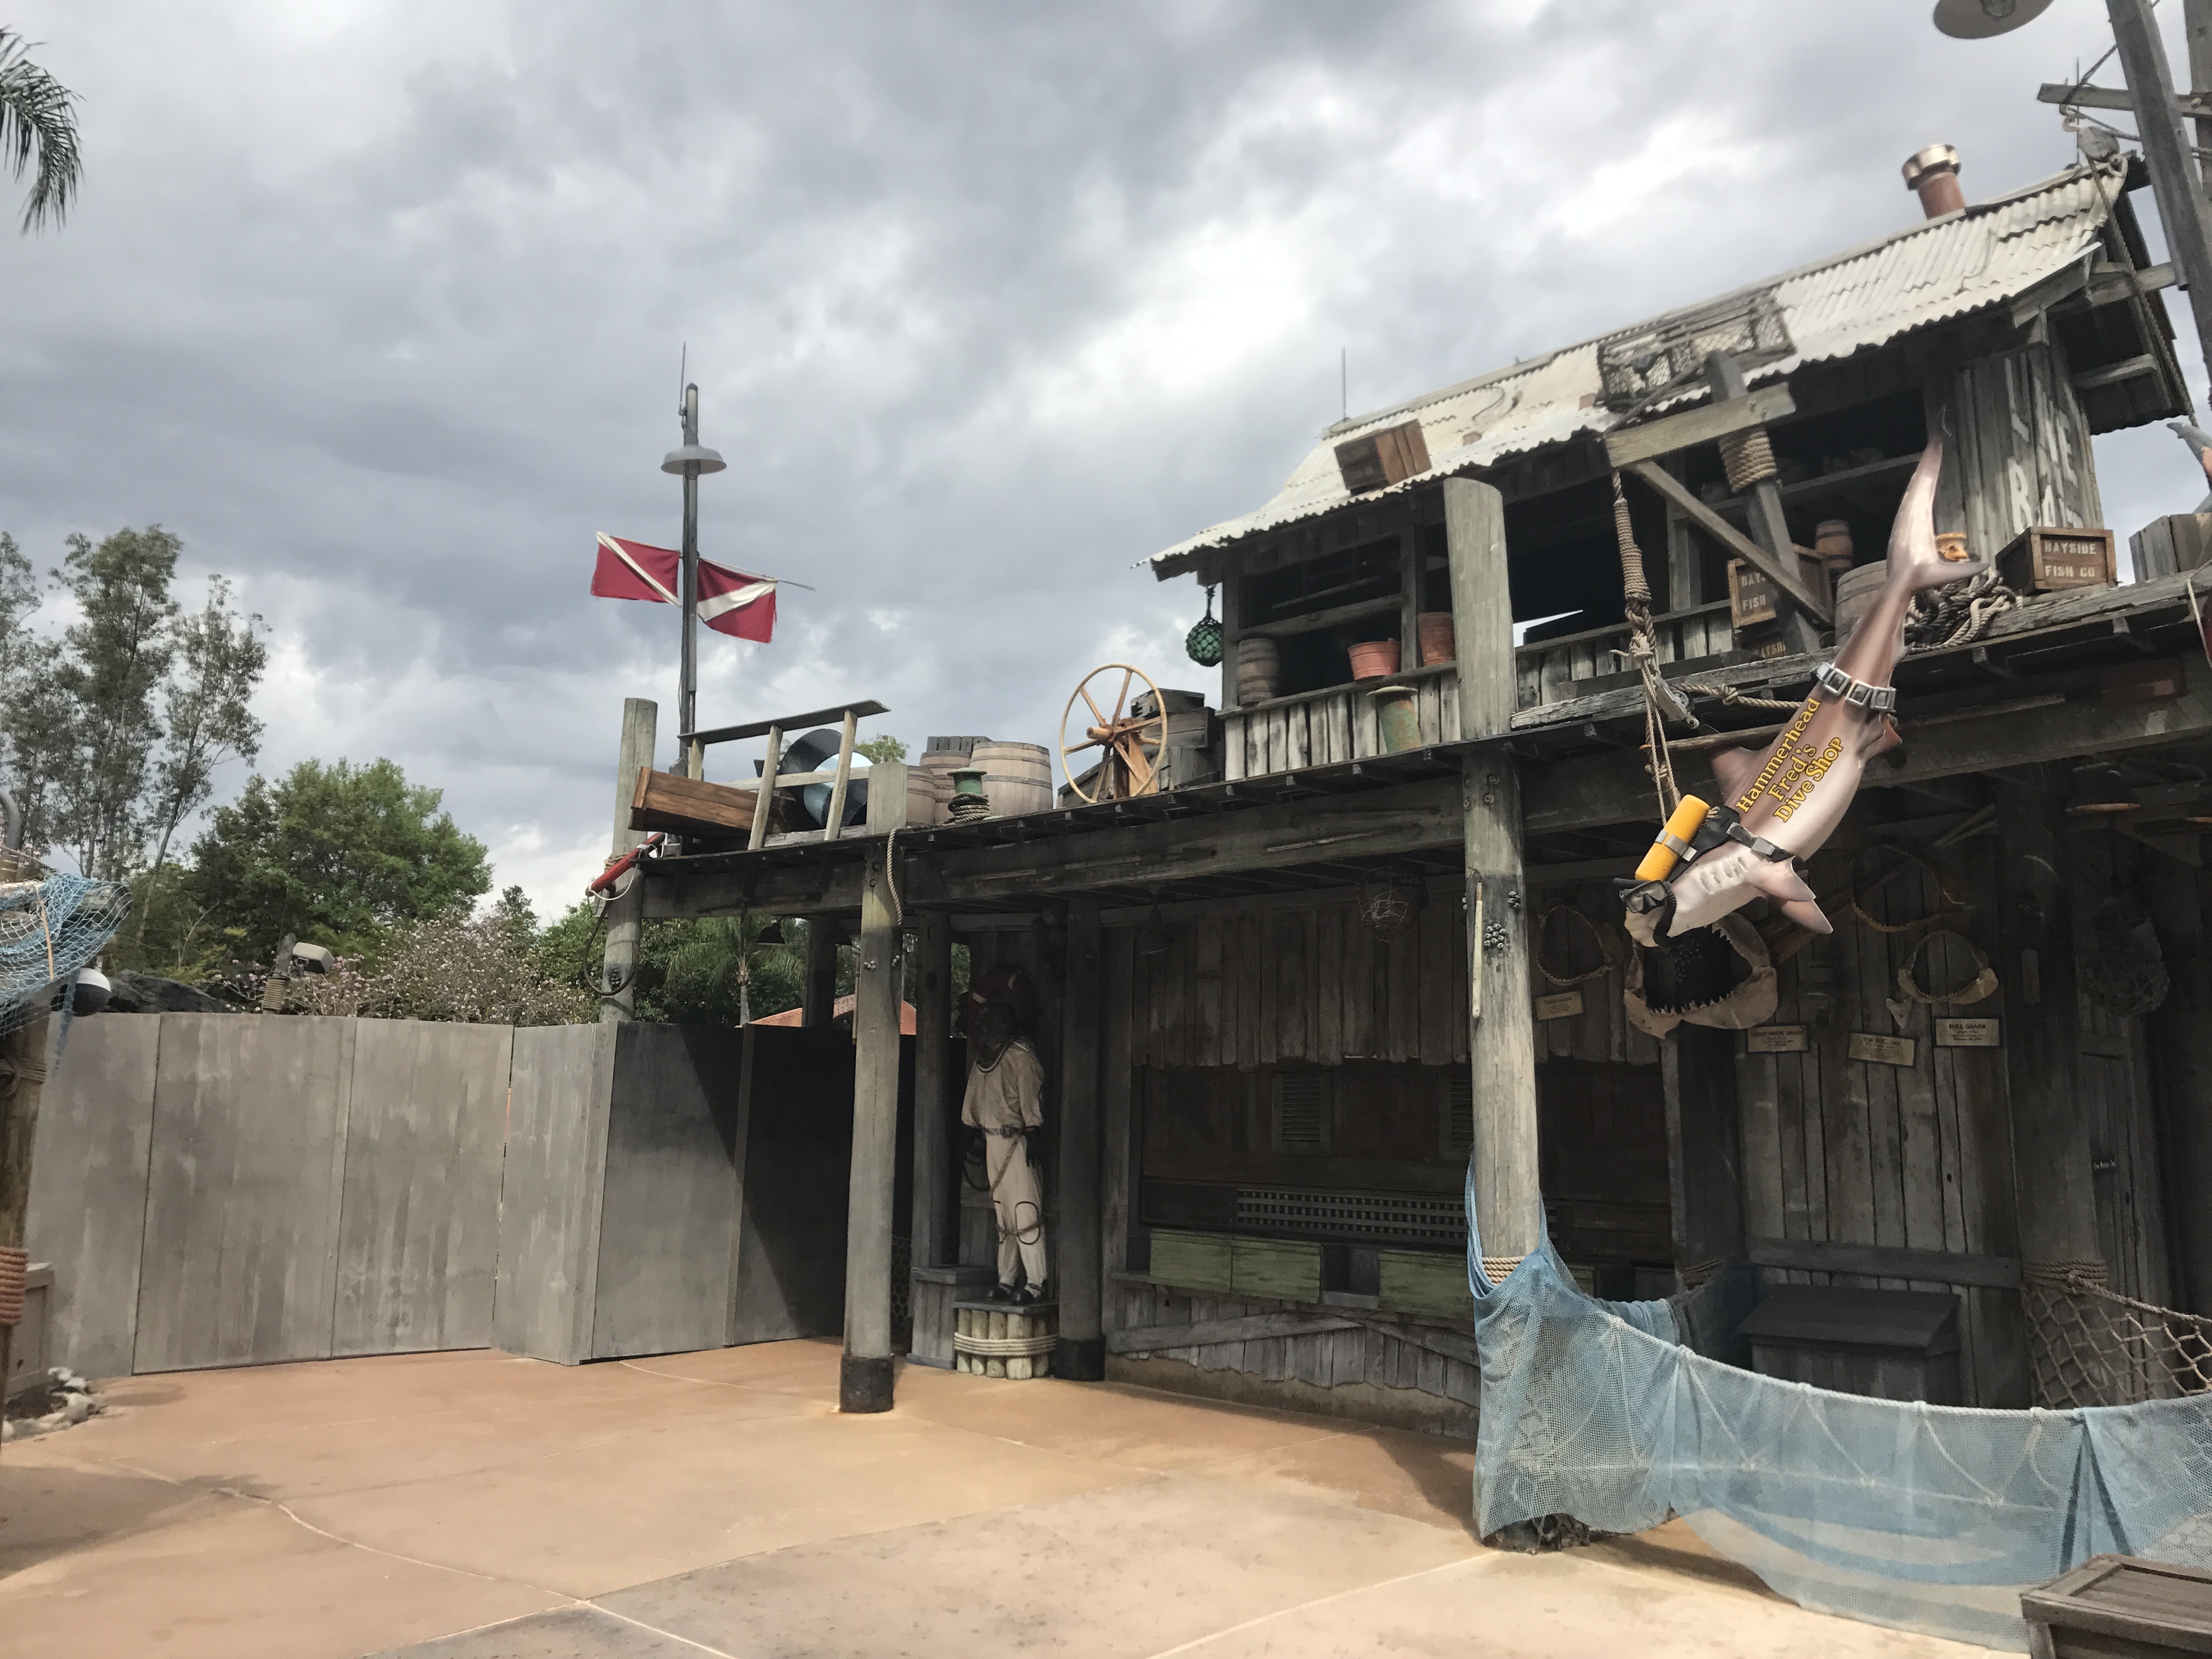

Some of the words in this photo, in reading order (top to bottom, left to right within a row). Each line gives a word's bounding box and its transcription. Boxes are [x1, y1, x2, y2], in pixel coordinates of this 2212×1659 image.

[2045, 541, 2096, 554] BAYSIDE
[2045, 566, 2074, 577] FISH
[2080, 567, 2095, 577] CO
[1742, 594, 1766, 611] FISH
[1735, 697, 1822, 813] Hammerhead
[1767, 743, 1817, 802] Fred's
[1773, 780, 1815, 822] Dive
